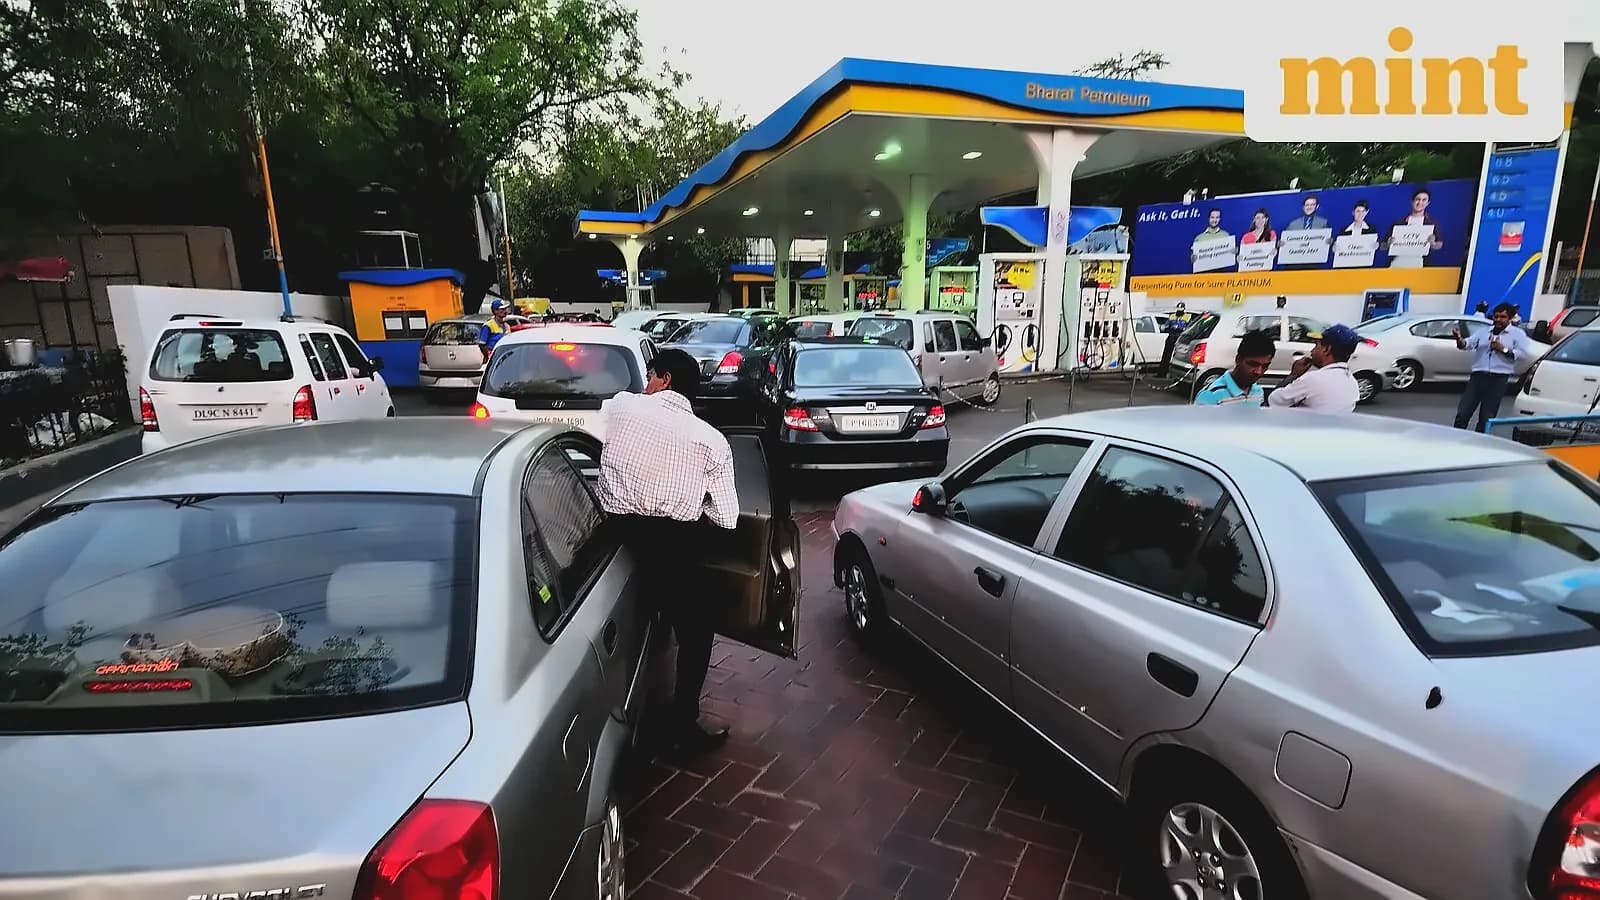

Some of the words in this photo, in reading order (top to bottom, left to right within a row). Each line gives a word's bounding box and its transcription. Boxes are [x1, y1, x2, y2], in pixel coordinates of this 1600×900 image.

[1026, 82, 1075, 99] Bharat
[1081, 86, 1151, 107] Petroleum
[1138, 212, 1157, 222] Ask
[1170, 209, 1189, 220] Get
[1134, 280, 1174, 290] Presenting
[1174, 280, 1192, 289] Pure
[1193, 279, 1205, 288] for
[1207, 280, 1226, 288] Sure
[1226, 278, 1272, 288] PLATINUM
[194, 408, 219, 418] DL9C
[222, 408, 230, 417] N
[232, 407, 254, 417] 8441
